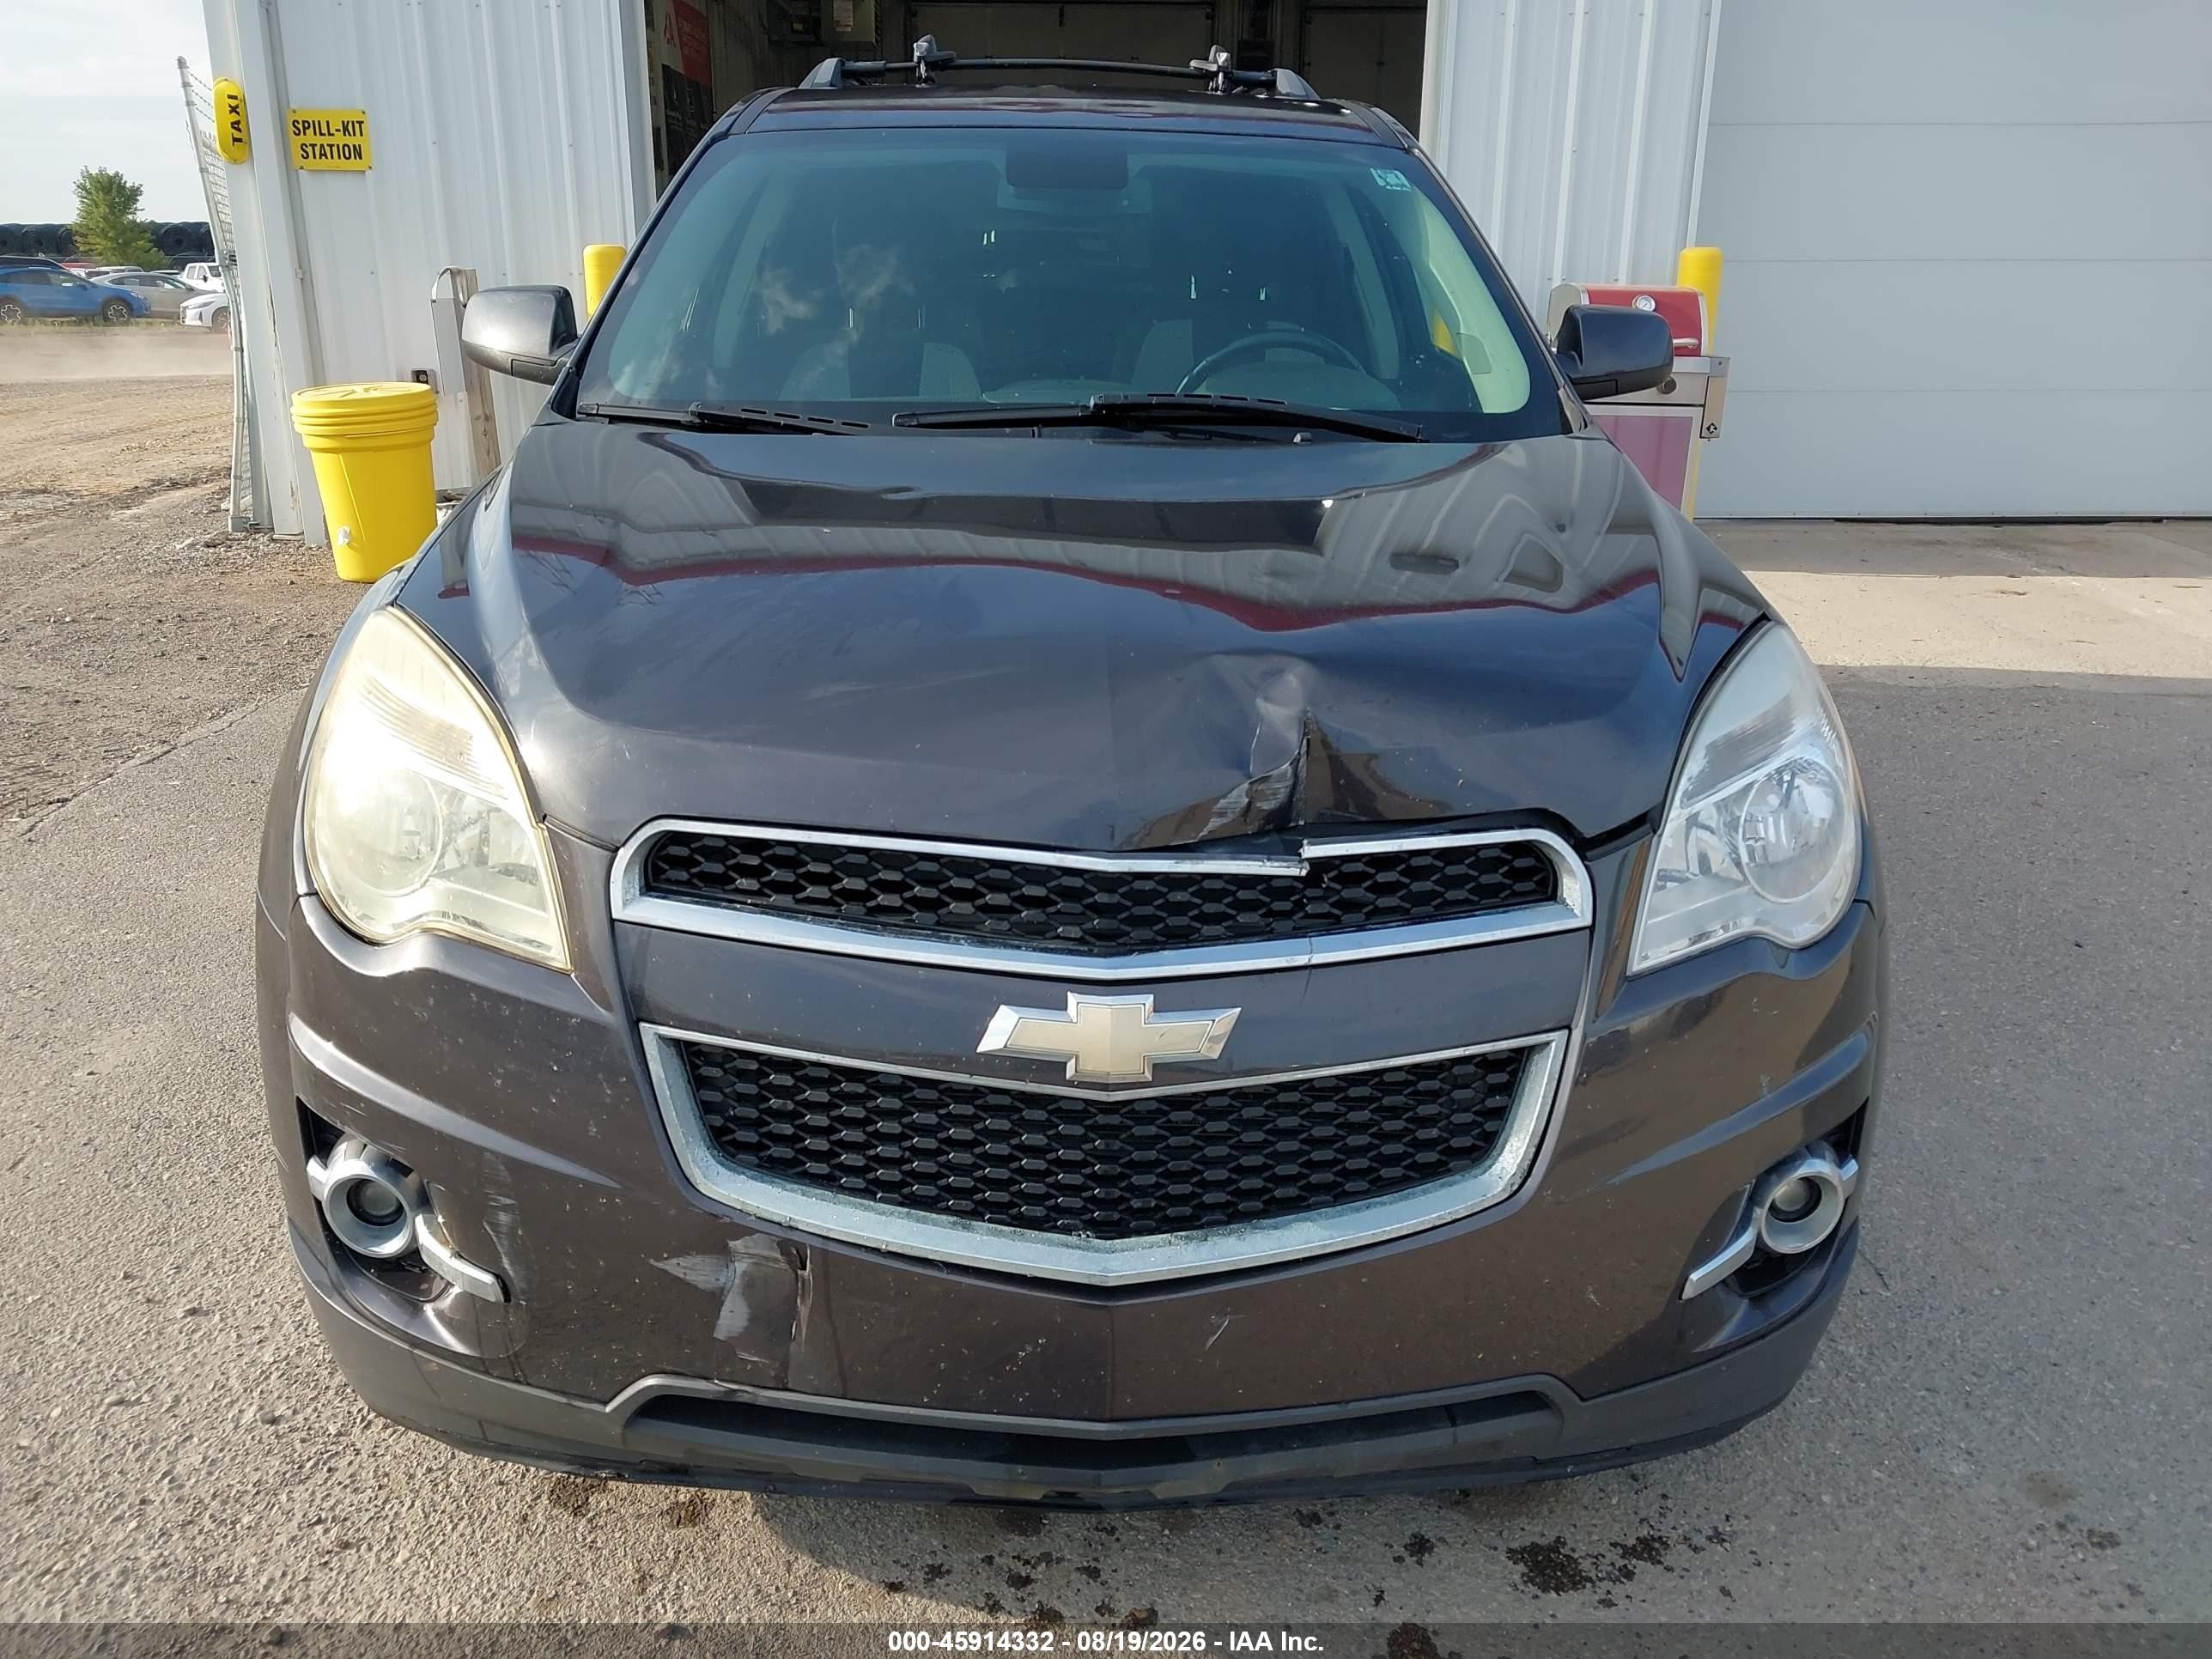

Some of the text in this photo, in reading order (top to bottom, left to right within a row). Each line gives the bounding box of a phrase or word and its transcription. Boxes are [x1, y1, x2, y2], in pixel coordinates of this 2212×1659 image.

[227, 94, 243, 146] TAXI
[292, 119, 365, 137] SPILL-KIT
[300, 143, 362, 161] STATION
